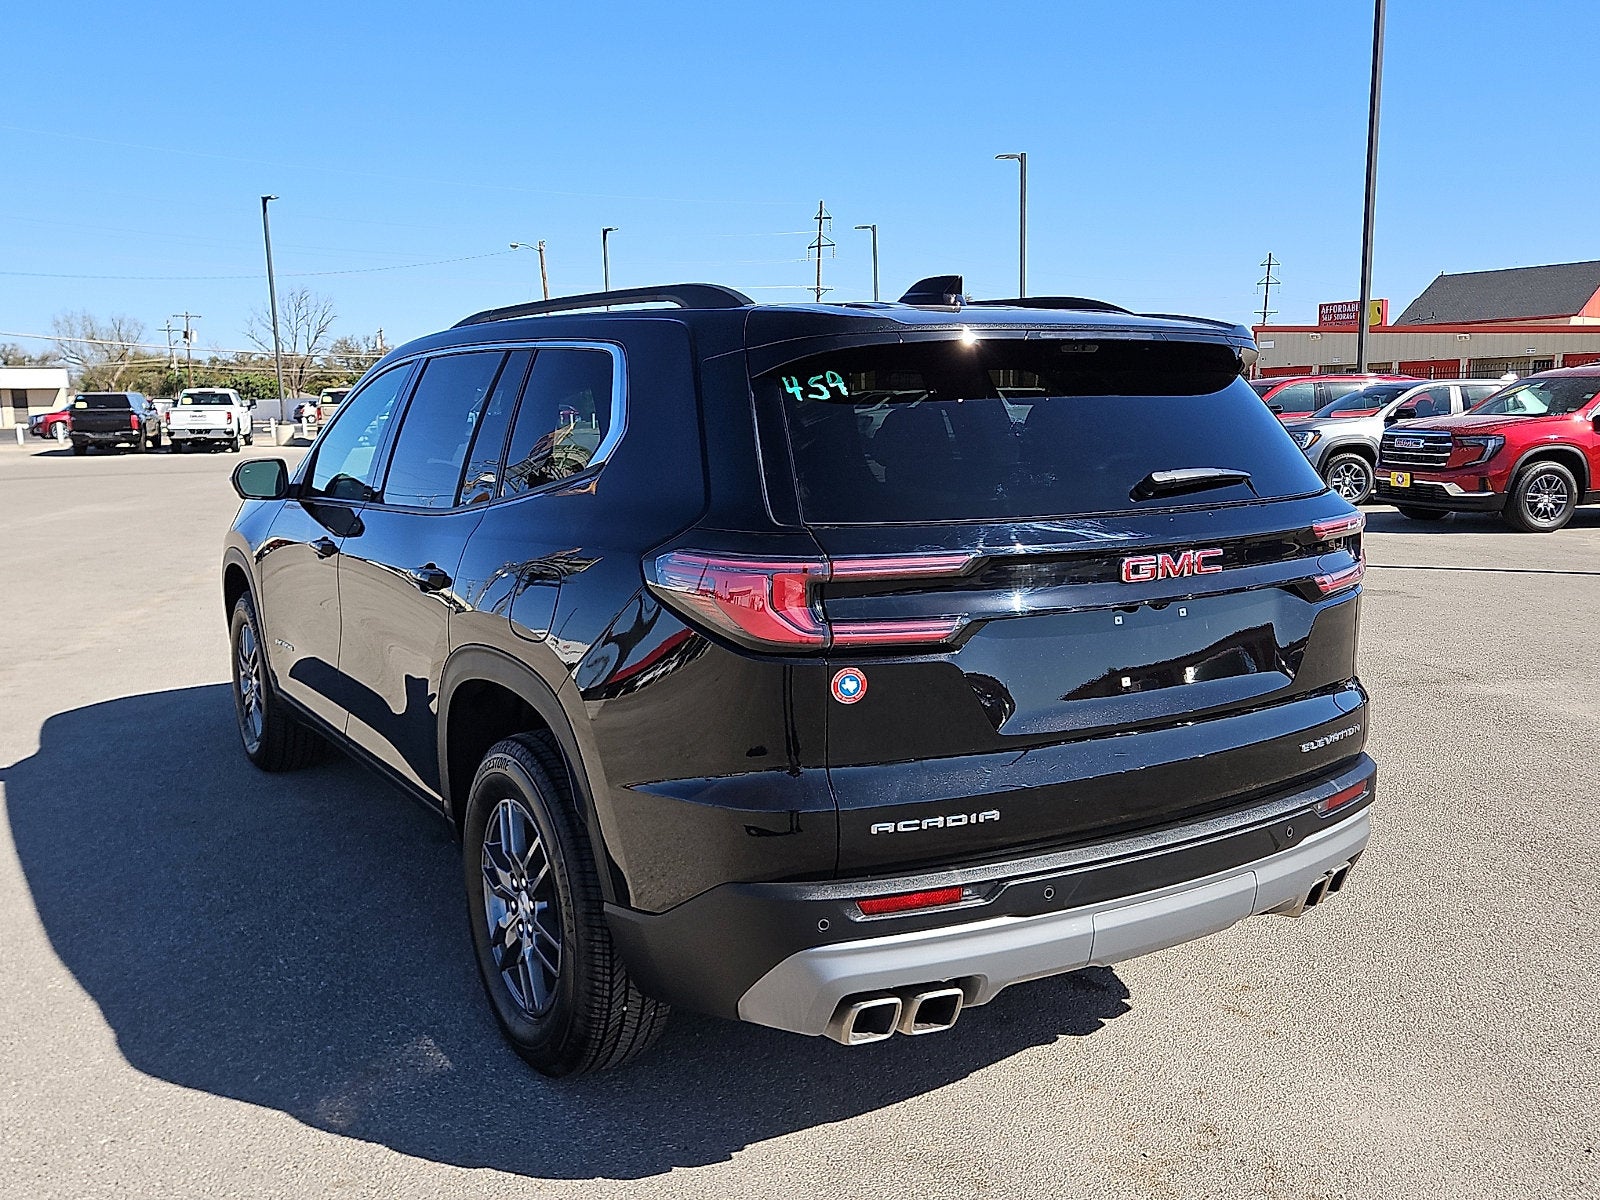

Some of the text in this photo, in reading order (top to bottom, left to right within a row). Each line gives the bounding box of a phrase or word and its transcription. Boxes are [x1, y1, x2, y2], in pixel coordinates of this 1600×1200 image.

[1321, 303, 1361, 314] AFFORDABL
[1322, 312, 1356, 321] SELF STORAGE
[781, 370, 849, 402] 459
[1121, 548, 1224, 583] GMC
[1298, 723, 1361, 753] ELEVATION
[870, 809, 1001, 835] ACADIA
